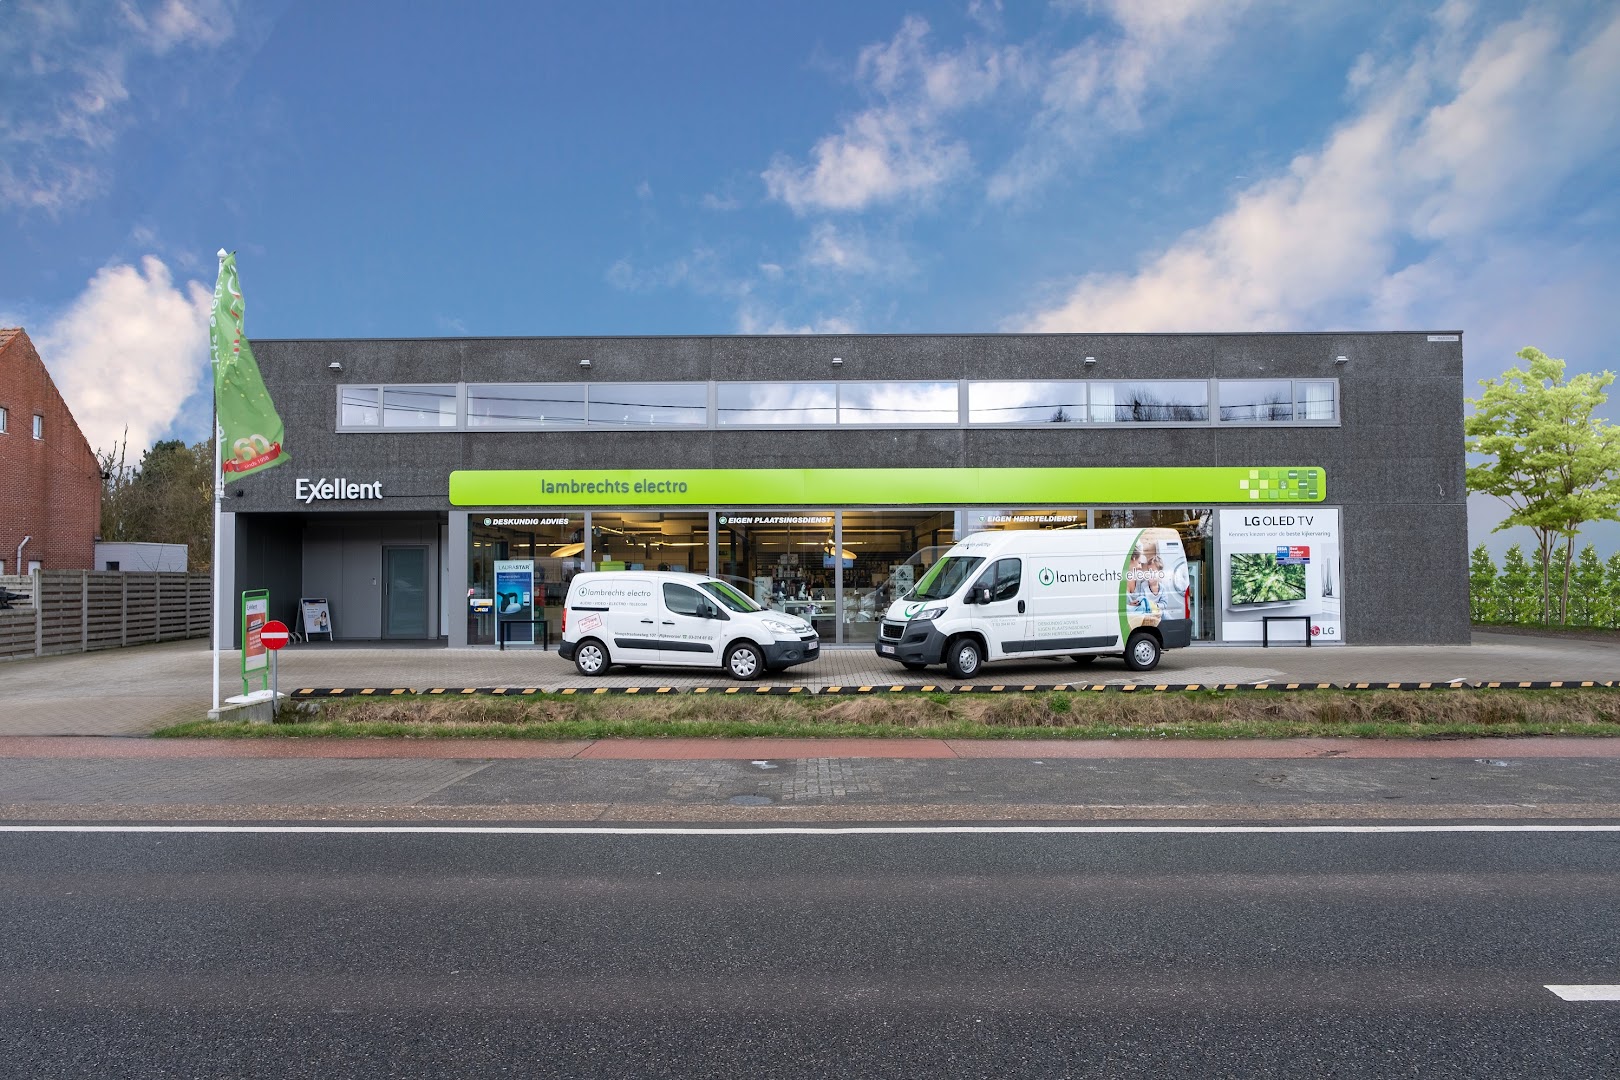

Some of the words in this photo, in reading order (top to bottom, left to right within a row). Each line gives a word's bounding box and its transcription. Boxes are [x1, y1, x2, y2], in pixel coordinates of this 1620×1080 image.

[233, 433, 271, 463] 60
[257, 455, 270, 464] 1958
[541, 478, 630, 493] lambrechts
[633, 478, 688, 493] electro
[295, 477, 384, 504] Exellent
[492, 518, 539, 526] DESKUNDIG
[754, 516, 832, 524] PLAATSINGSDIENST
[987, 515, 1013, 523] EIGEN
[1013, 515, 1078, 523] HERSTELDIENST
[1244, 516, 1261, 527] LG
[1262, 515, 1295, 526] OLED
[1298, 515, 1314, 526] TV
[1301, 530, 1331, 538] kijkervaring
[1056, 568, 1123, 583] lambrechts
[1126, 567, 1165, 581] electro
[587, 588, 626, 597] lambrechts
[627, 589, 652, 597] electro
[1322, 627, 1335, 635] LG
